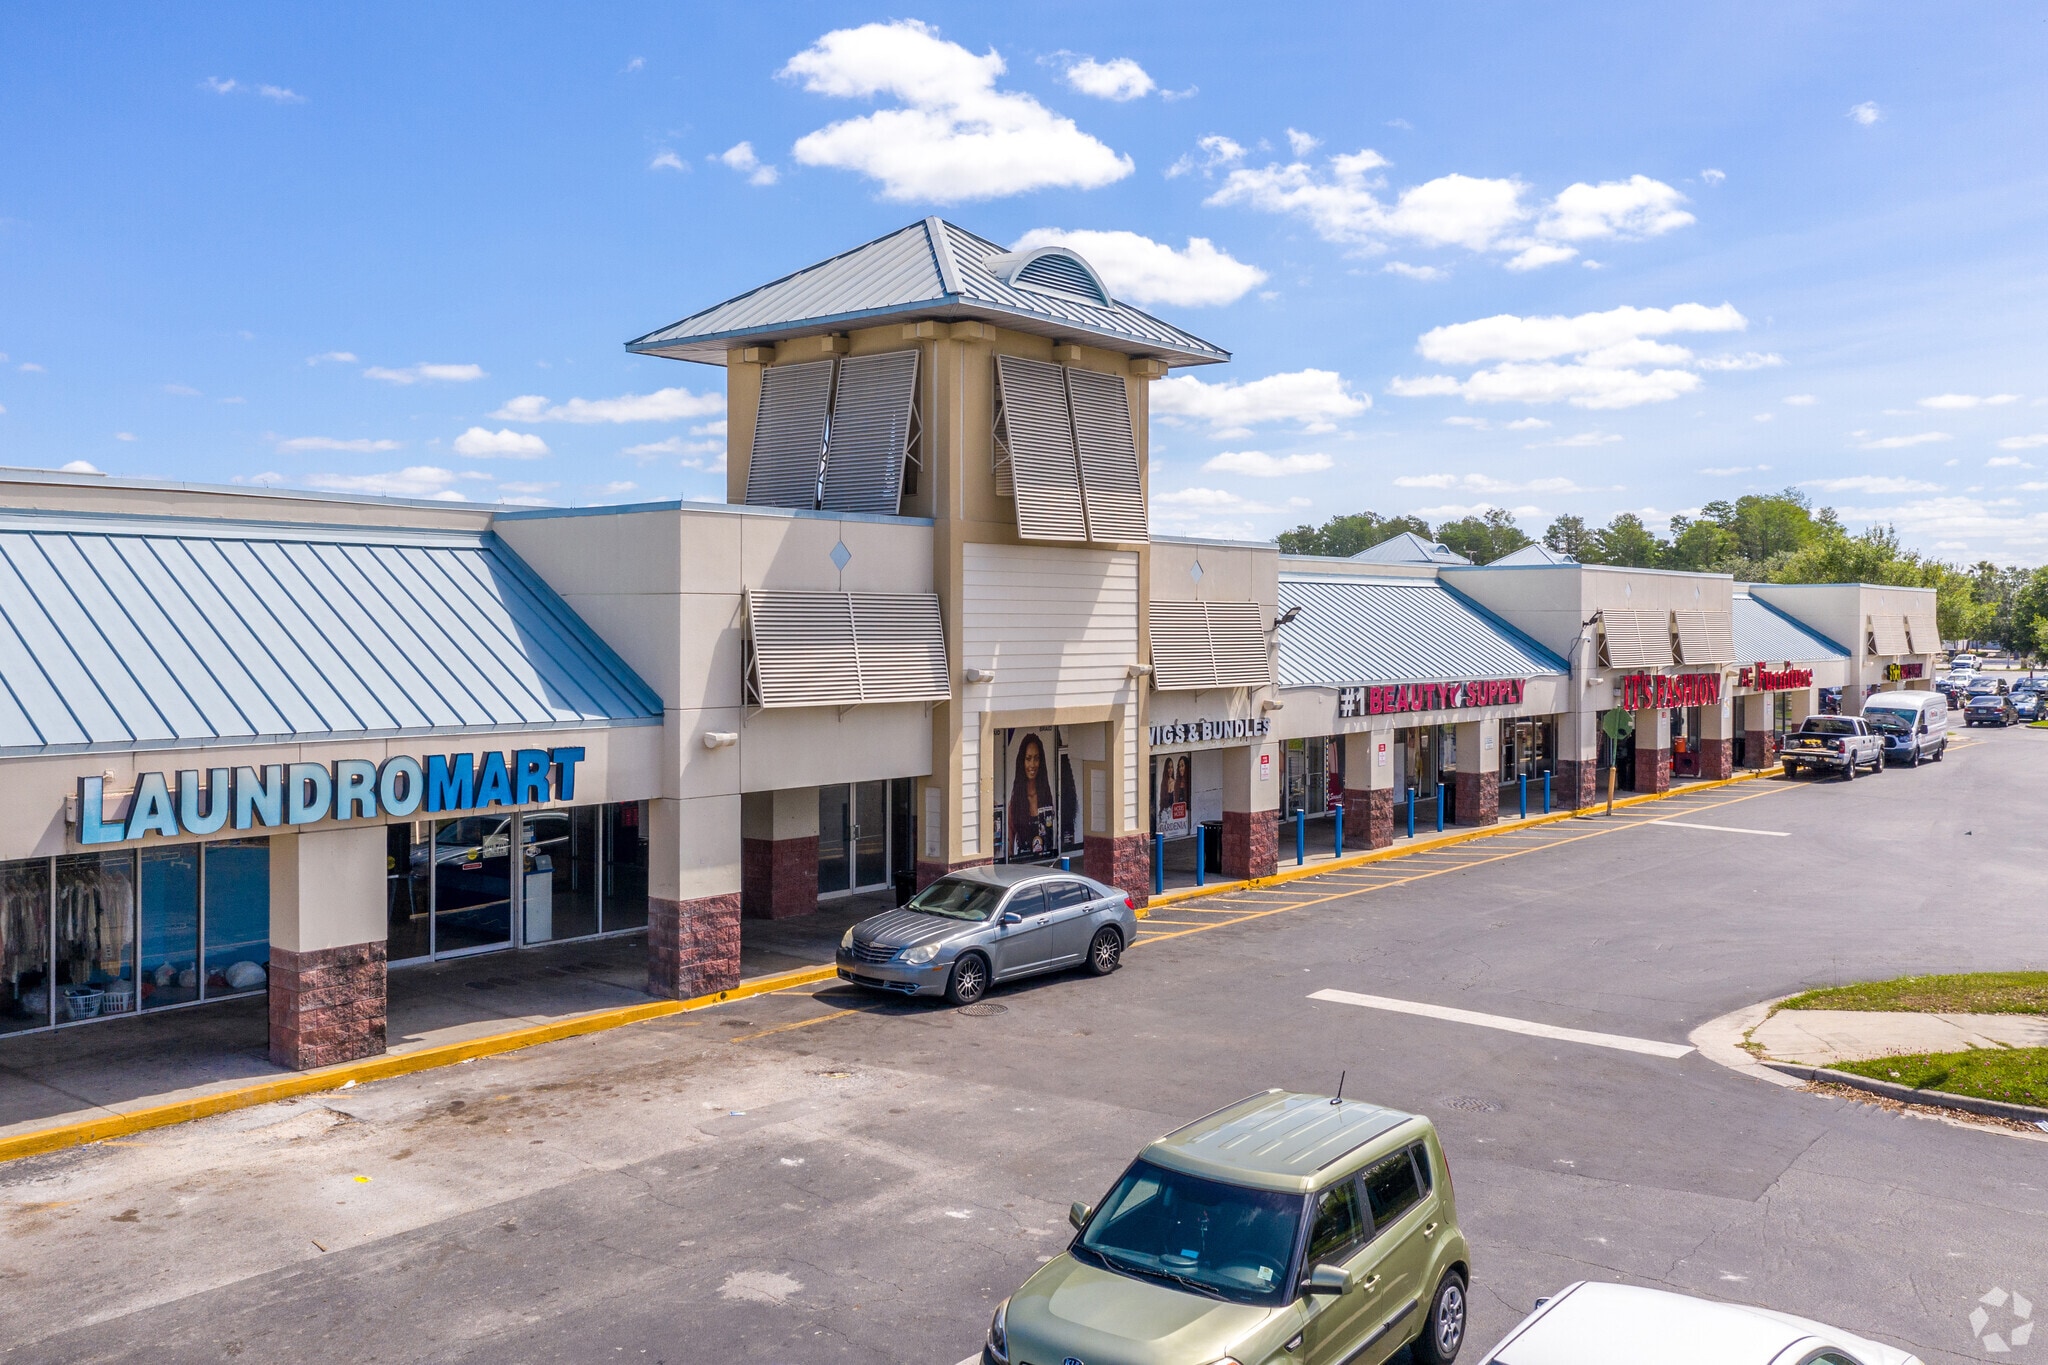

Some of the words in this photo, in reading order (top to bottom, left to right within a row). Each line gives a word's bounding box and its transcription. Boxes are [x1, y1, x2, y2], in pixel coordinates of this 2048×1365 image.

[1340, 686, 1365, 717] #1
[1370, 682, 1449, 715] BEAUTY
[1466, 679, 1526, 708] SUPPLY
[1622, 671, 1653, 711] IT'S
[1656, 673, 1720, 709] FASHION
[1188, 723, 1199, 743] &
[1202, 718, 1271, 741] BUNDLES
[77, 746, 586, 845] LAUNDROMART
